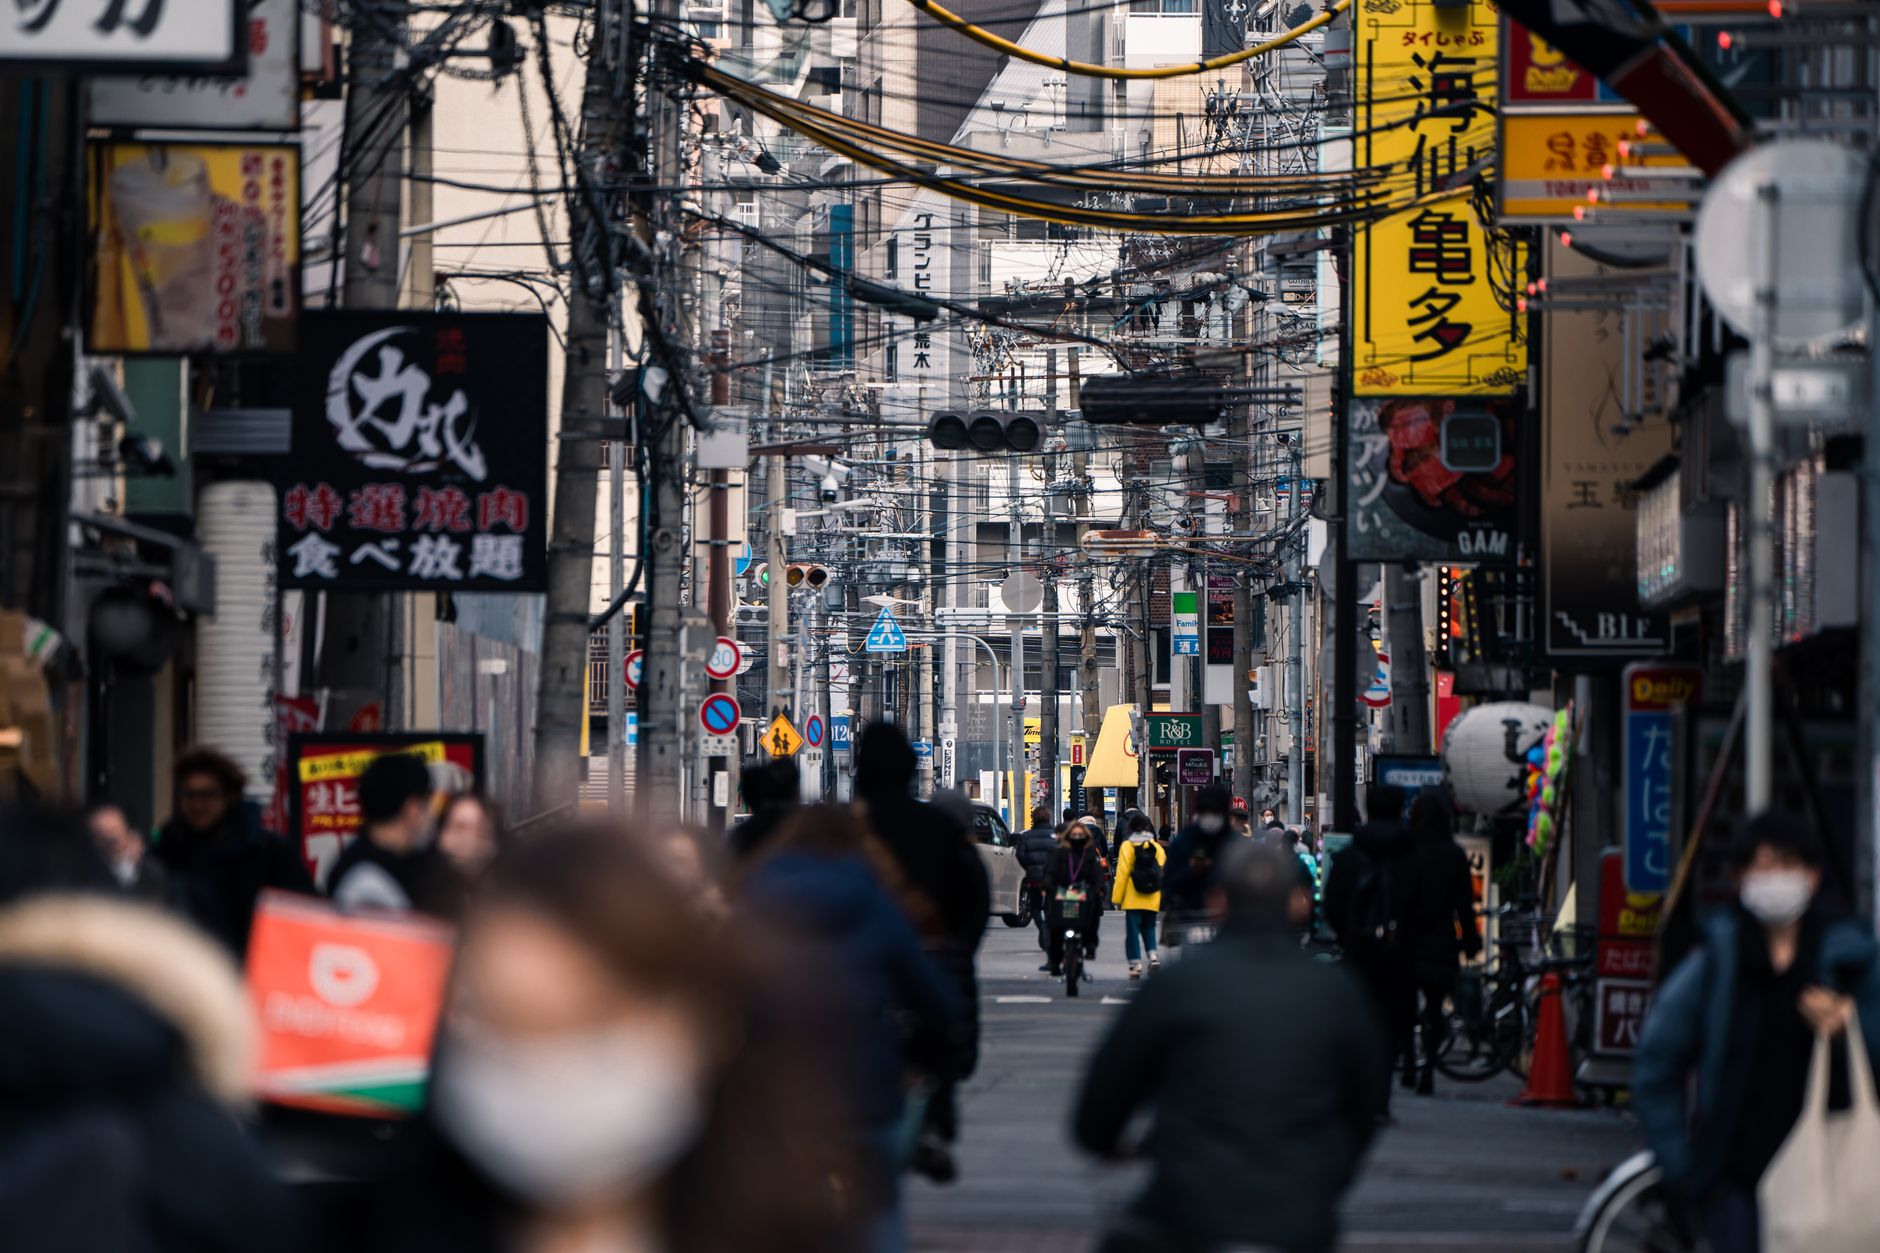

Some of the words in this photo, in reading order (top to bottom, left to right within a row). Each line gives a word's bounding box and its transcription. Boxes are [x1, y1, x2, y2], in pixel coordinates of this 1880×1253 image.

[913, 213, 933, 369] グランビ荒木
[284, 483, 529, 532] 特選焼肉
[287, 532, 525, 580] 食べ放題
[1457, 529, 1508, 556] GAM
[711, 653, 733, 668] 30
[831, 725, 849, 741] 12
[1160, 722, 1192, 739] R&B
